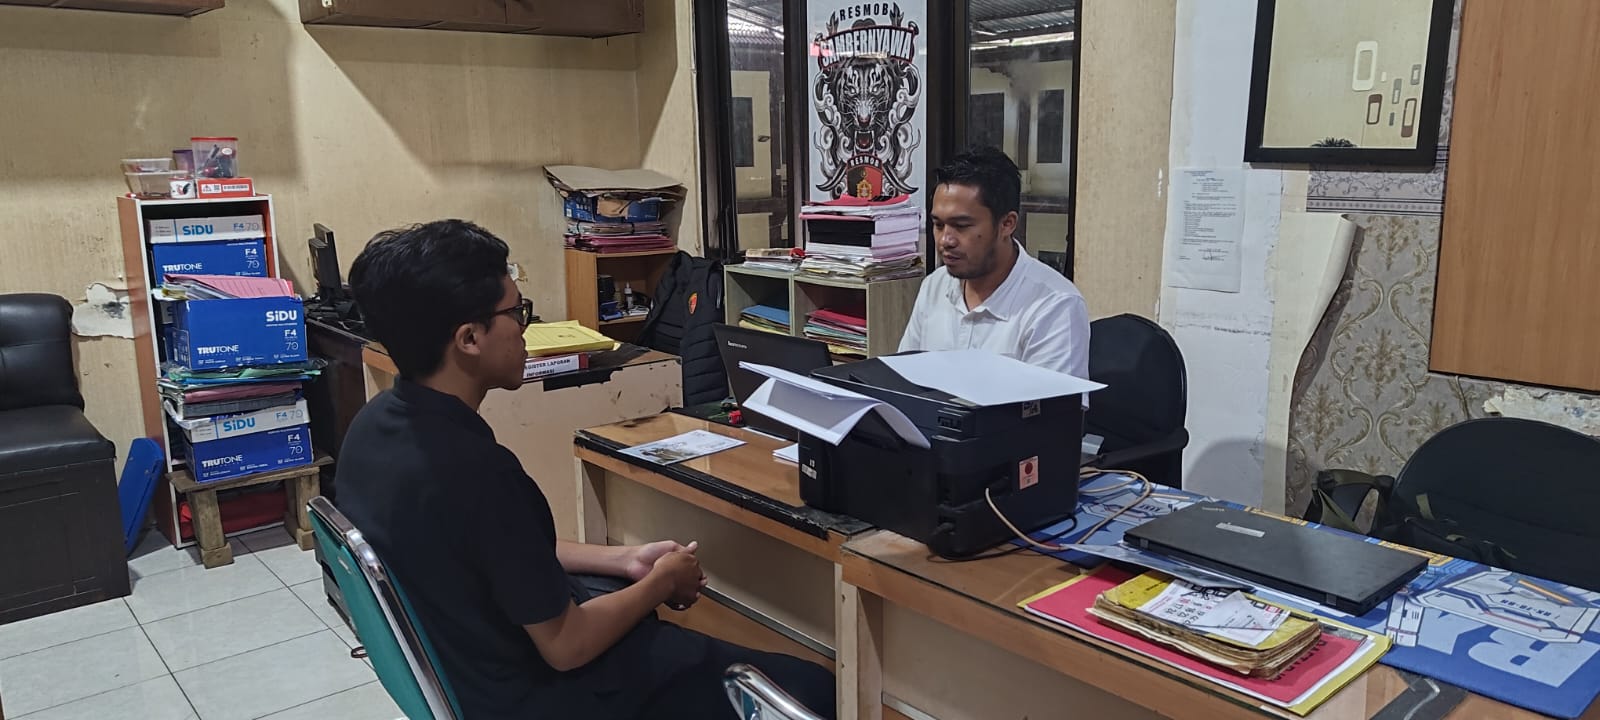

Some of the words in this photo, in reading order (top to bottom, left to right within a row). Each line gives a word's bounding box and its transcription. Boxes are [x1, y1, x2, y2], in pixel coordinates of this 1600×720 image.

[840, 3, 889, 21] RESMOB
[821, 29, 912, 66] SAMBERNYAWA
[182, 224, 214, 236] SiDU
[162, 262, 203, 272] TRUTONE
[266, 310, 298, 322] SiDU
[284, 329, 297, 337] F4
[197, 344, 239, 355] TRUTONE
[222, 417, 256, 432] SiDU
[275, 411, 288, 419] F4
[287, 433, 301, 442] F4
[201, 454, 243, 468] TRUTONE
